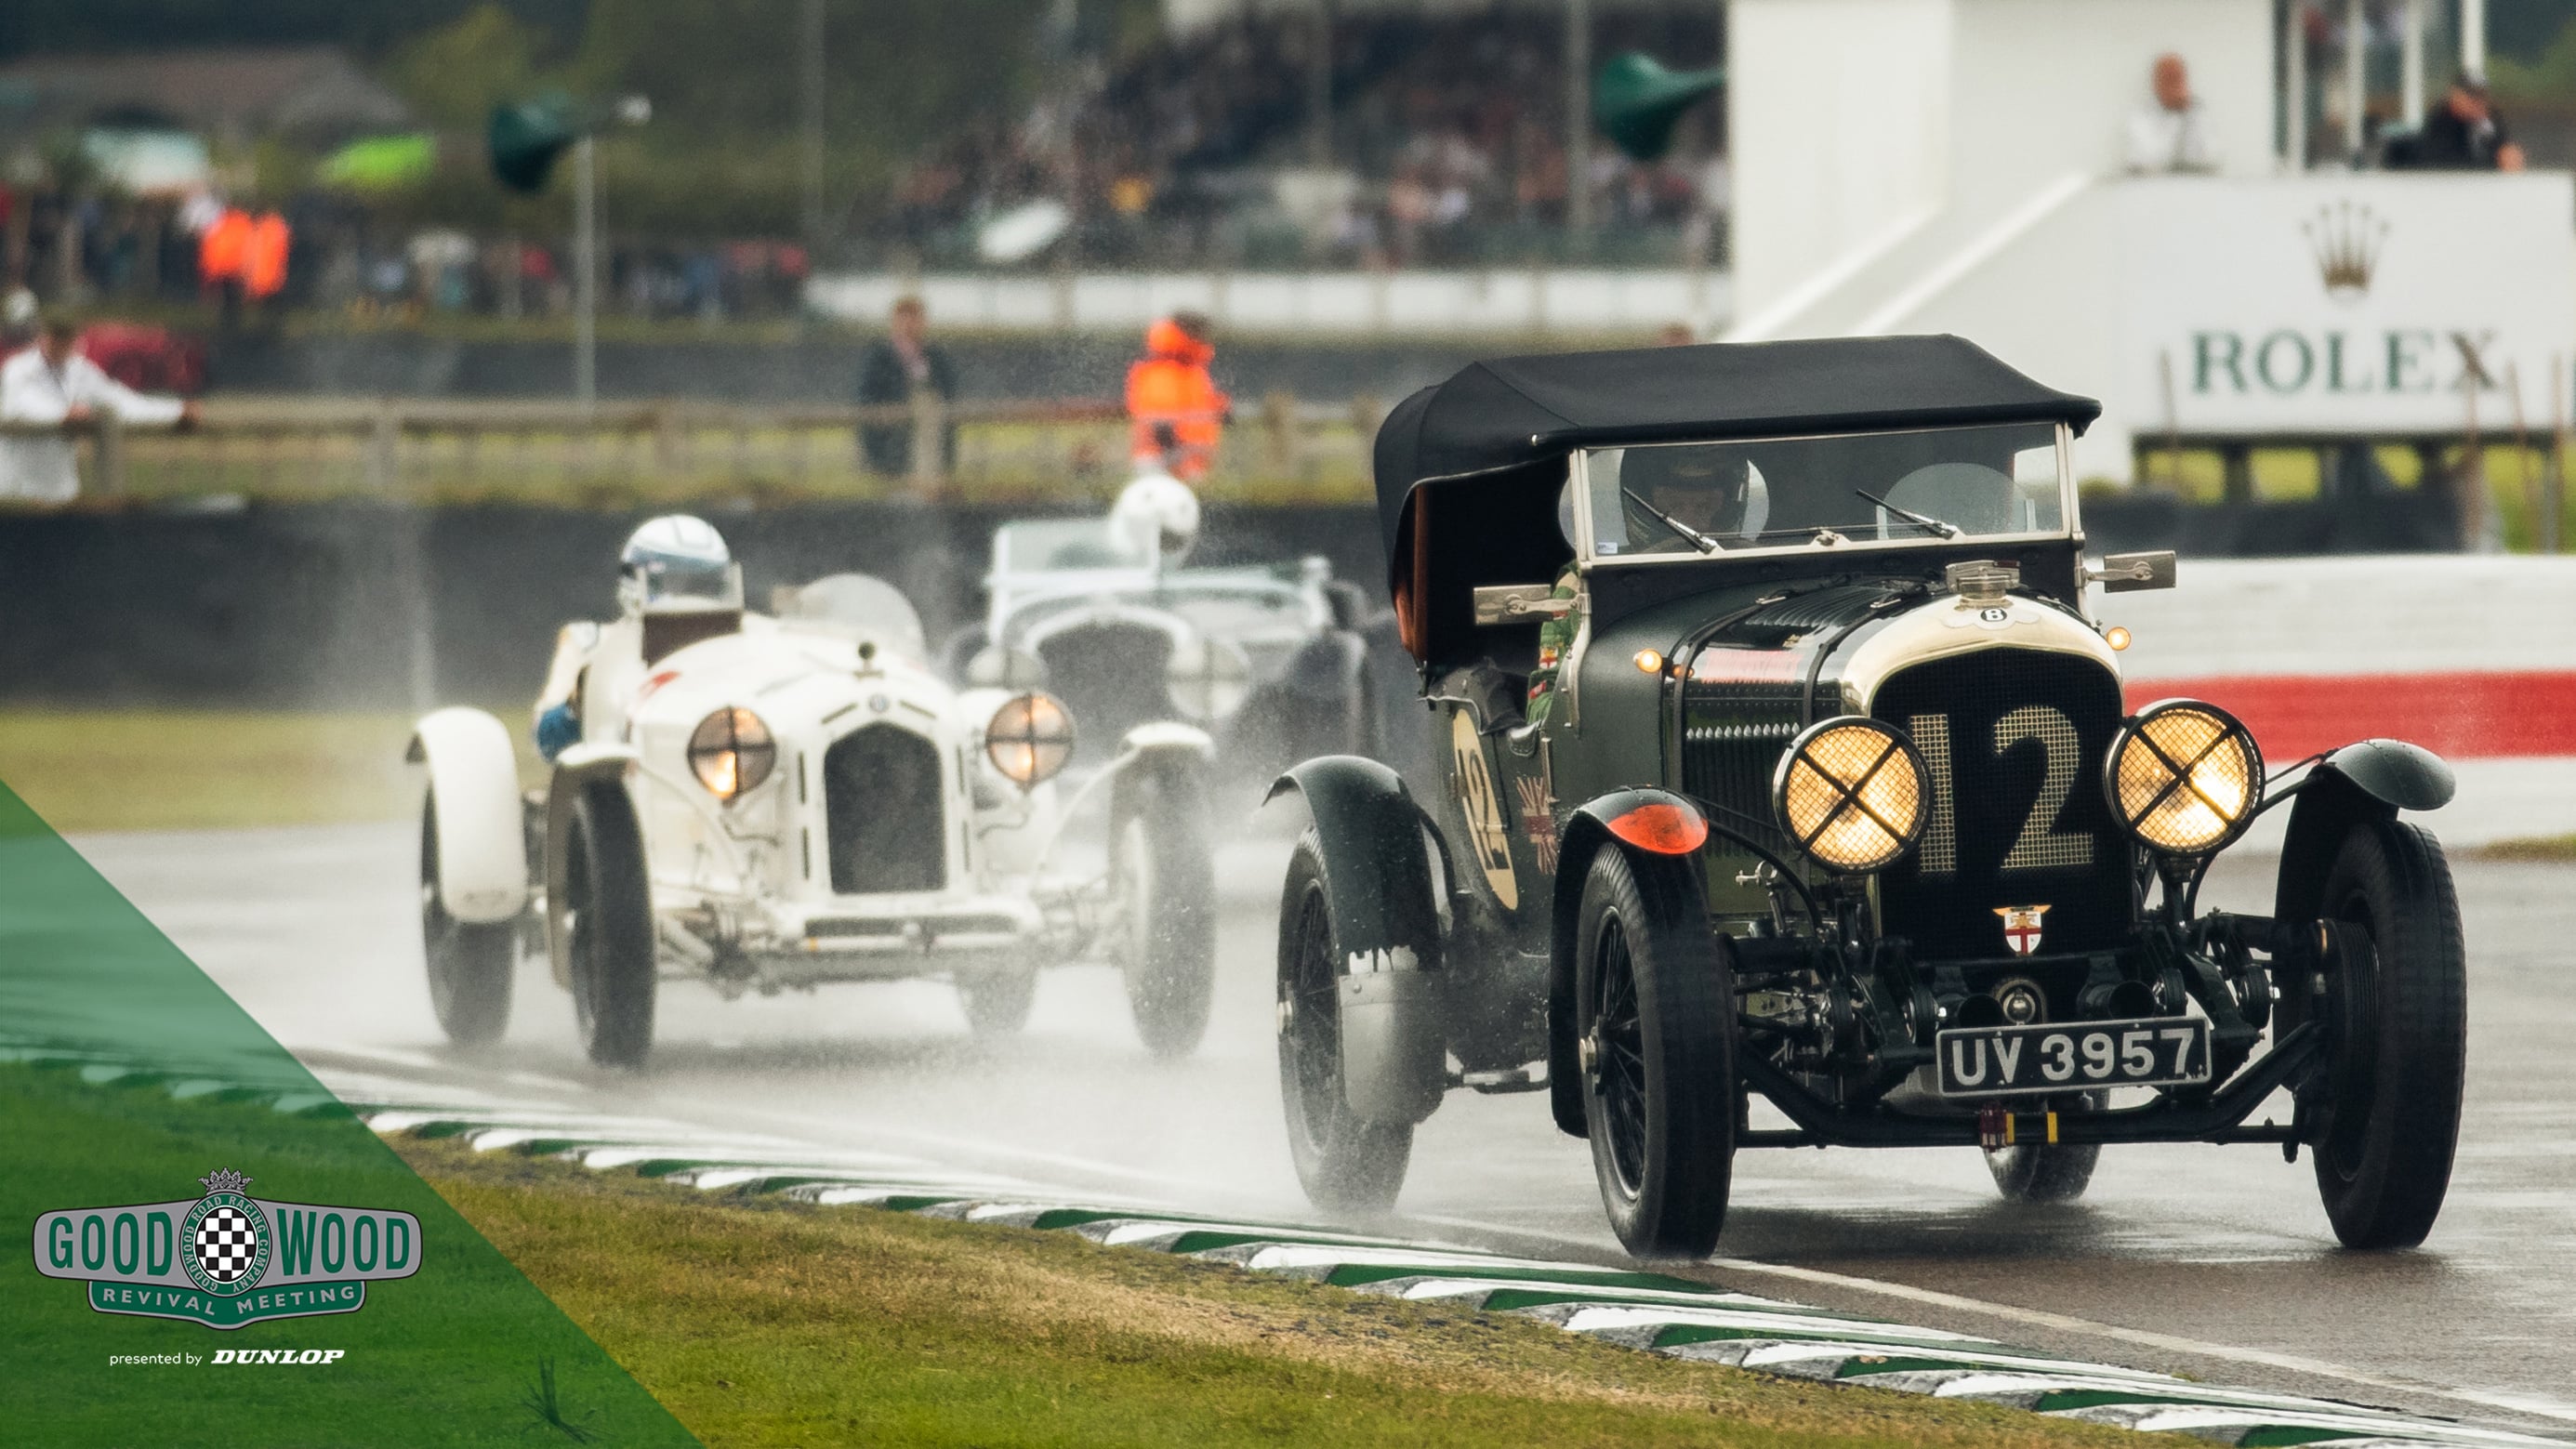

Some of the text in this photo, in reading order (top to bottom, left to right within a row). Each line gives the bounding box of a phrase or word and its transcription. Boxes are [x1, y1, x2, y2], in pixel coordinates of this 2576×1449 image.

[2190, 328, 2503, 394] ROLEX
[1458, 748, 1511, 870] 12
[1909, 705, 2094, 872] 12
[1952, 1028, 2195, 1087] UV 3957
